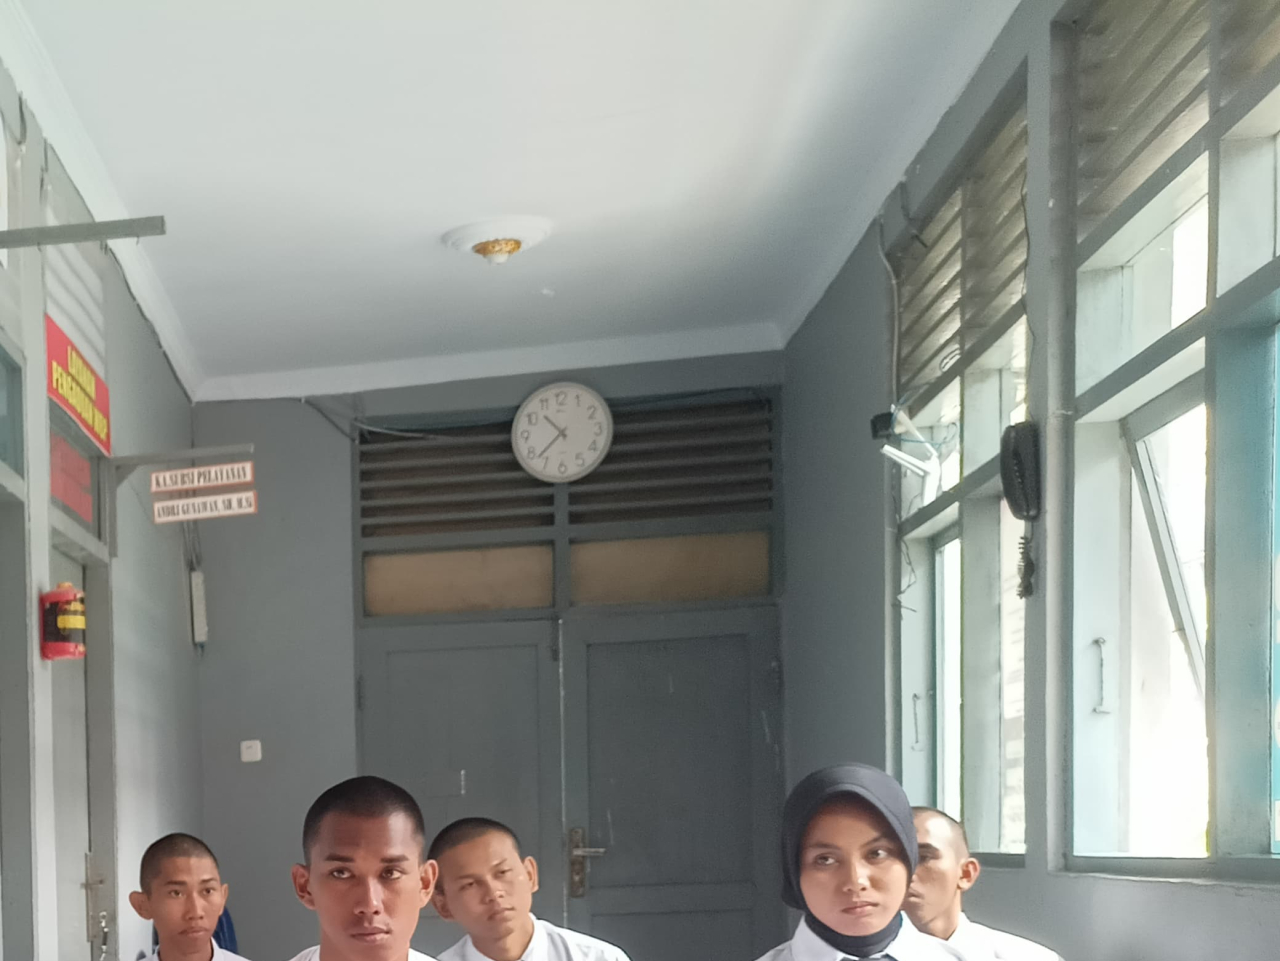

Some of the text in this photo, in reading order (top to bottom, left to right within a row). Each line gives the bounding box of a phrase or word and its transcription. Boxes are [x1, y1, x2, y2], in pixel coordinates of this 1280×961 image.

[539, 398, 549, 410] 11
[554, 391, 567, 406] 12
[575, 395, 581, 407] 1
[526, 412, 538, 426] 10
[587, 405, 597, 419] 2
[520, 429, 530, 443] 9
[593, 422, 603, 437] 3
[527, 446, 536, 459] 8
[587, 440, 598, 452] 4
[542, 456, 549, 470] 7
[575, 453, 585, 467] 5
[557, 461, 567, 474] 6
[197, 466, 247, 484] PELAYANAN
